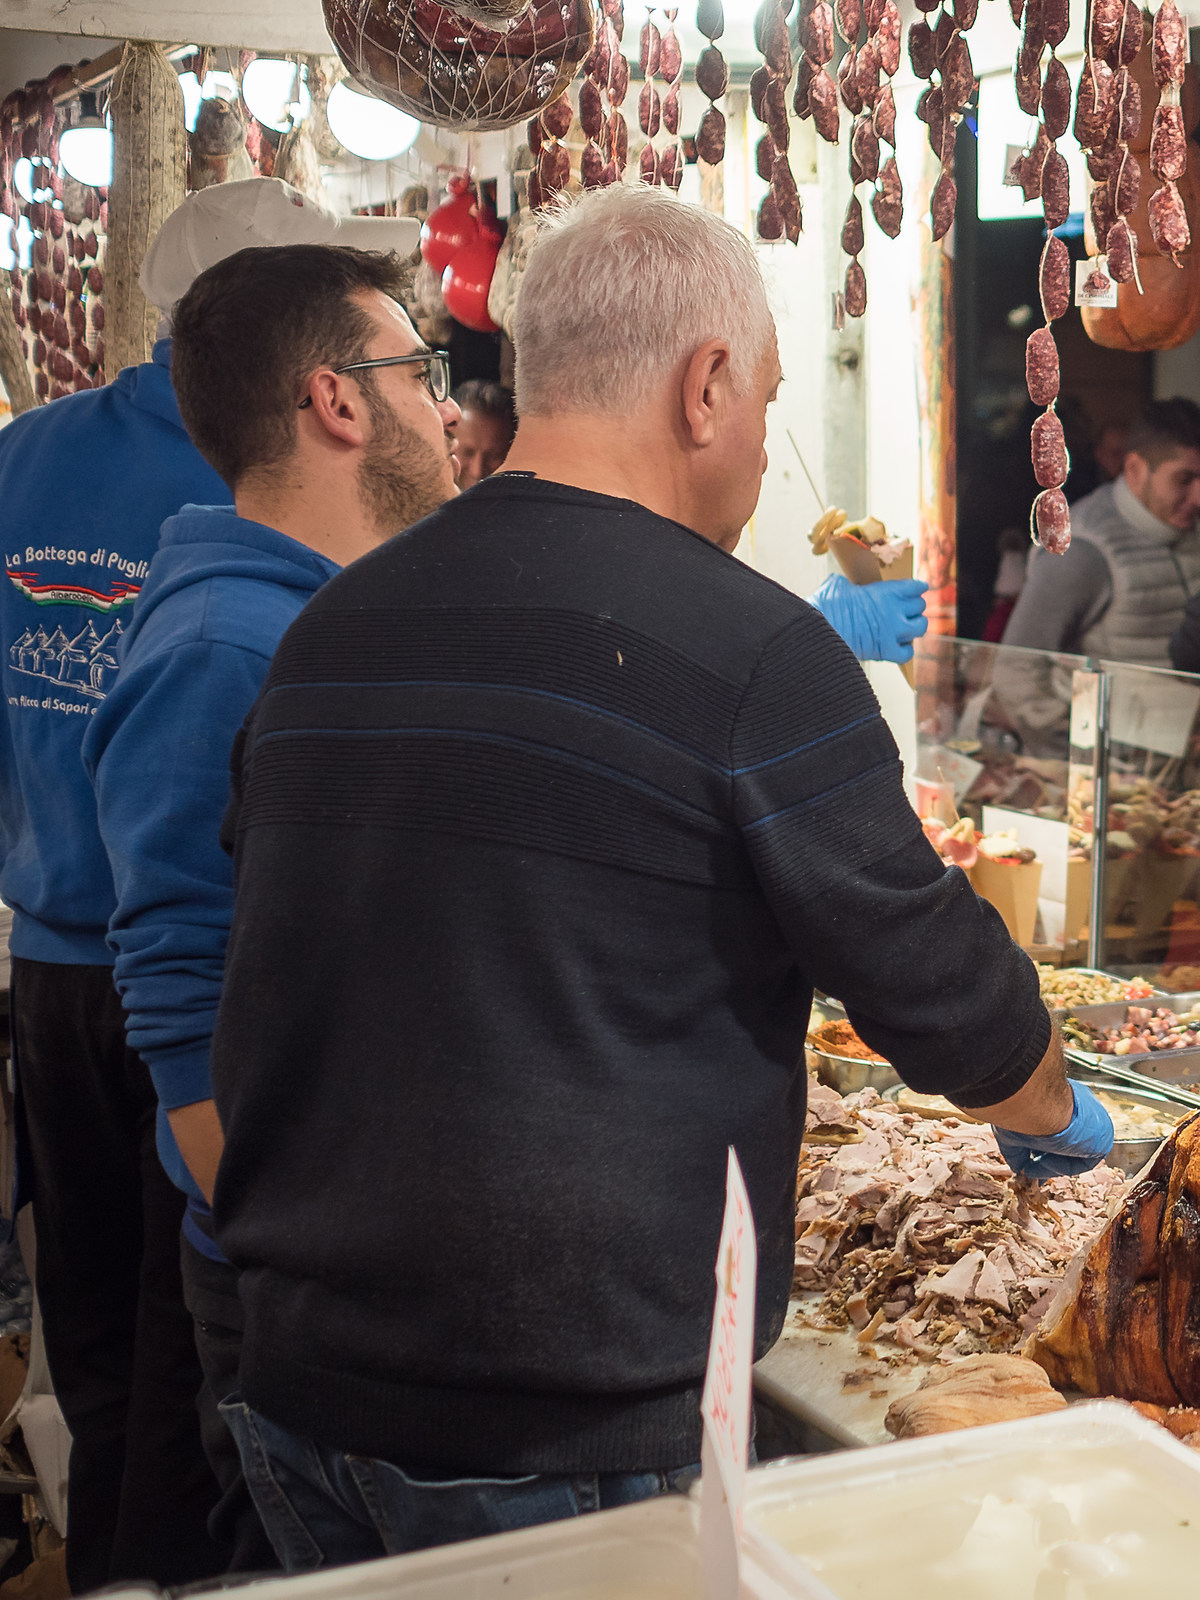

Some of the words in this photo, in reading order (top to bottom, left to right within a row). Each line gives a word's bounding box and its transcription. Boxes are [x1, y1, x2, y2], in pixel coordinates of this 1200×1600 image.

[5, 553, 21, 567] La
[25, 546, 87, 566] Bottega
[90, 548, 106, 566] di
[41, 697, 51, 709] di
[52, 698, 90, 715] Sapori
